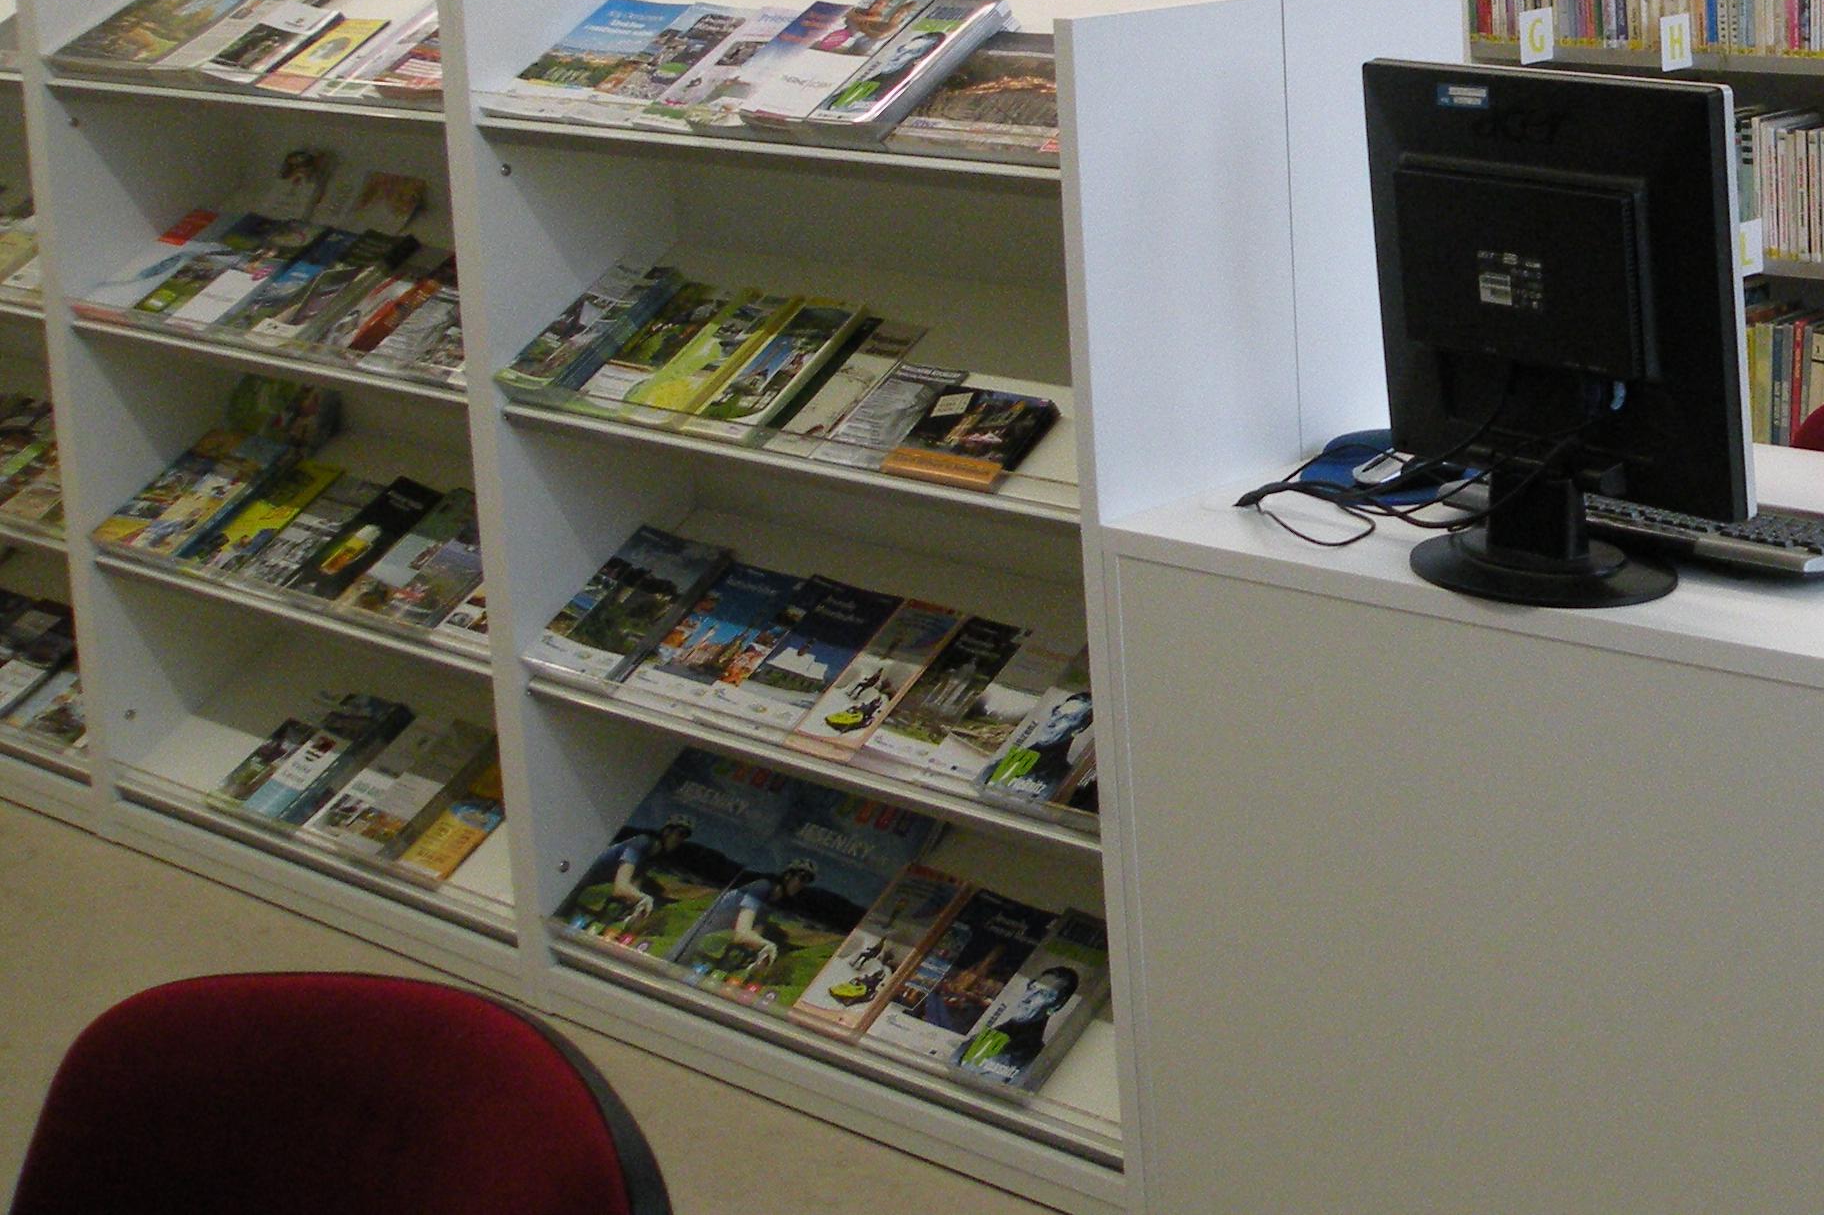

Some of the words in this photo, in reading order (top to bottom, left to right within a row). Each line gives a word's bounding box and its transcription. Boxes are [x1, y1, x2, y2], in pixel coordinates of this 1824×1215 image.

[1527, 18, 1545, 54] G
[1668, 23, 1684, 61] H
[1739, 231, 1754, 267] L
